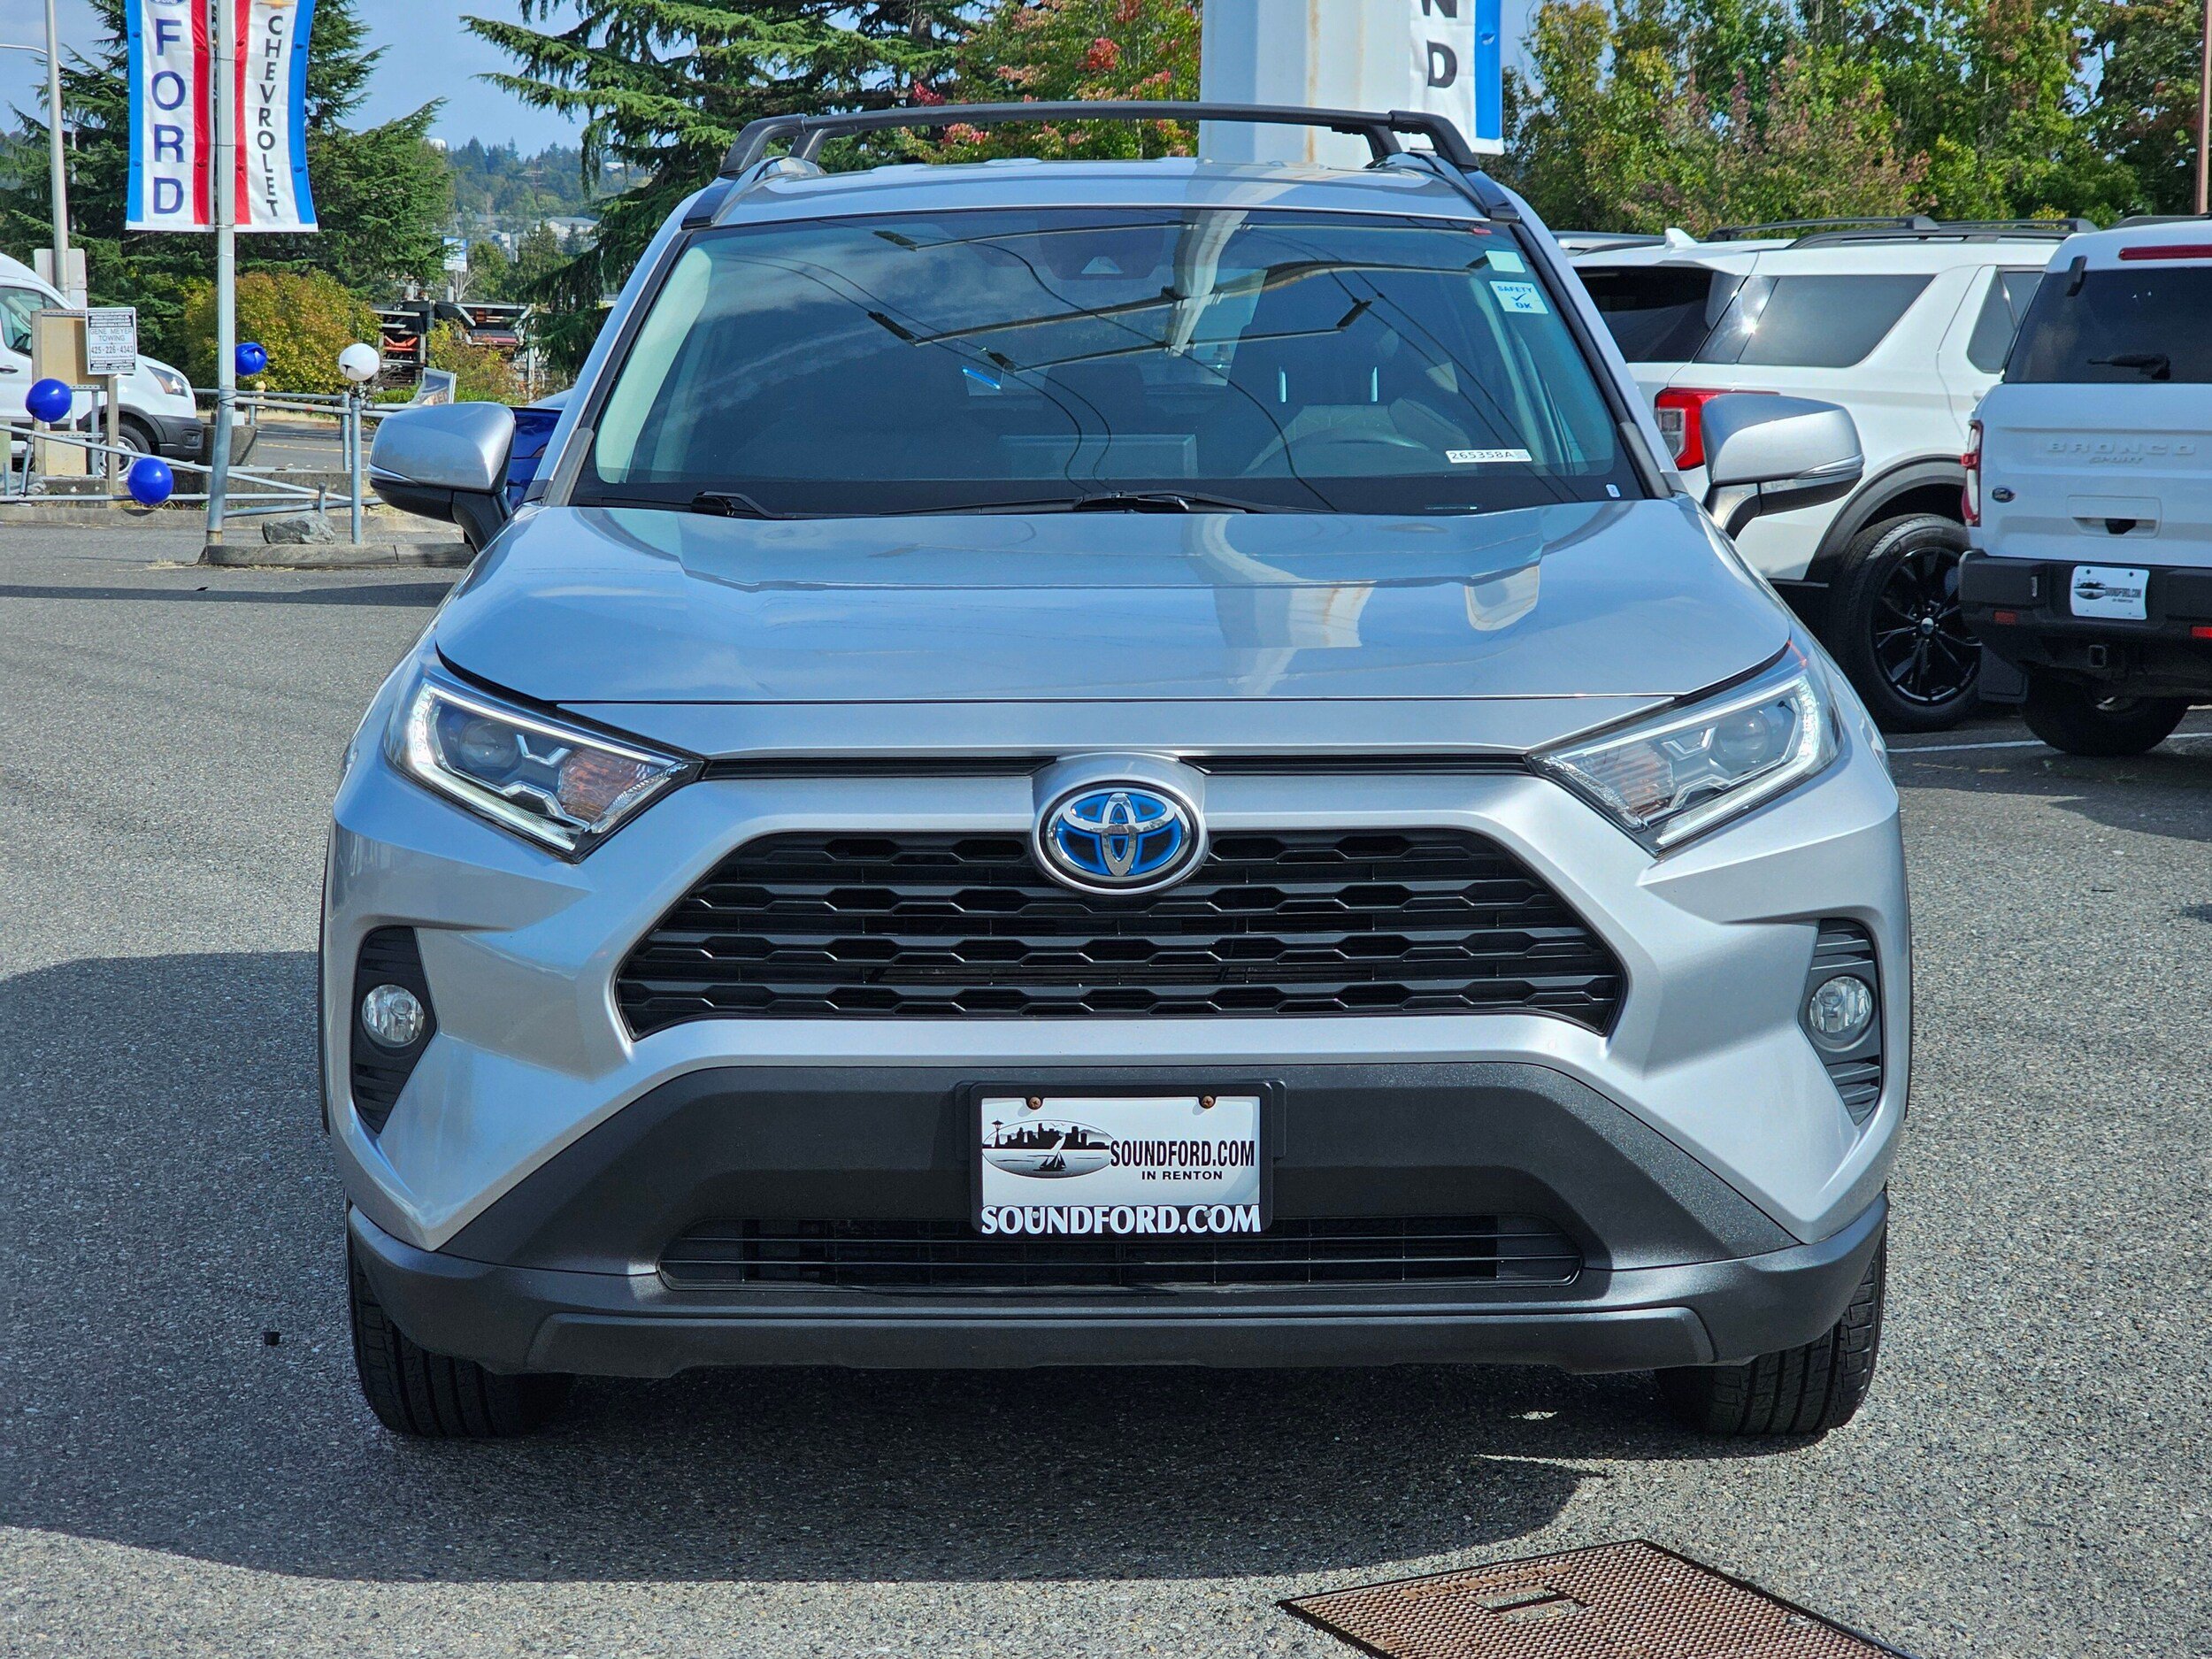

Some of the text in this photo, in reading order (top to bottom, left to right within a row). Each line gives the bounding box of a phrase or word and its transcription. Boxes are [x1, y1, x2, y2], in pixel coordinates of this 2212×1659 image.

[151, 18, 186, 214] FORD
[257, 15, 283, 217] CHEVROLET
[1448, 450, 1515, 460] 265358A
[2047, 442, 2196, 456] BRONCO
[1110, 1140, 1255, 1167] SOUNDFORD.COM
[1141, 1171, 1223, 1180] IN RENTON
[980, 1204, 1262, 1234] SOUNDFORD.COM
